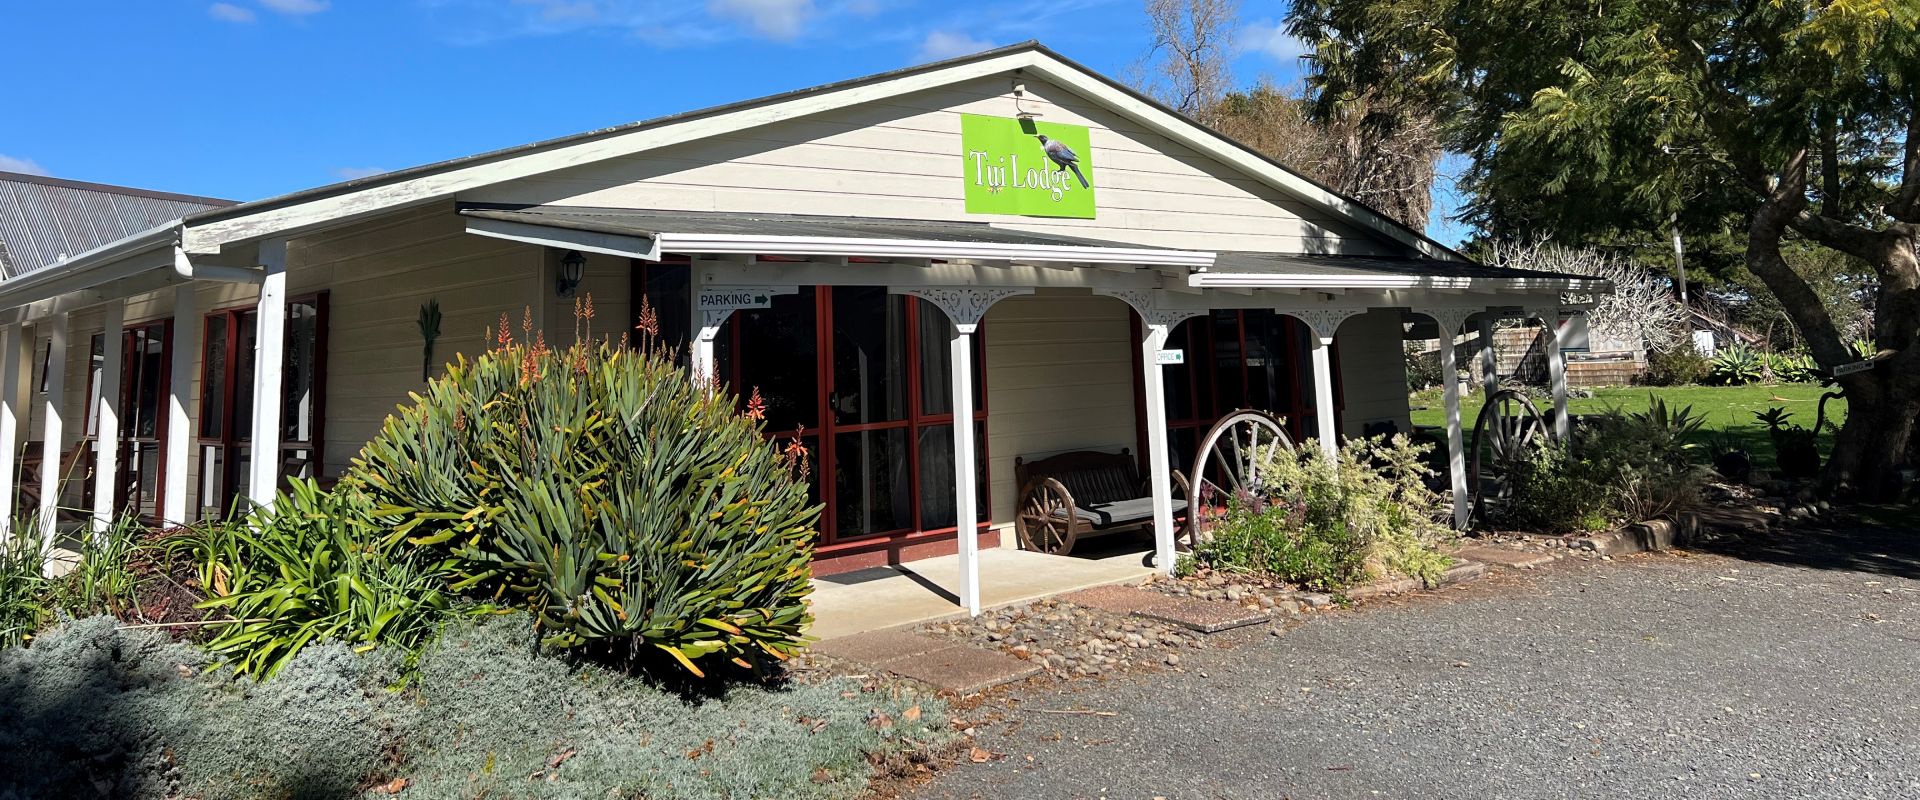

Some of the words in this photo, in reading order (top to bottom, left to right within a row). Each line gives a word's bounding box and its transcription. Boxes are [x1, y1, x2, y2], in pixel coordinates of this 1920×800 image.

[969, 149, 1006, 188] Tui
[1010, 154, 1072, 203] Lodge
[701, 294, 751, 306] PARKING
[1157, 352, 1174, 361] OFFICE
